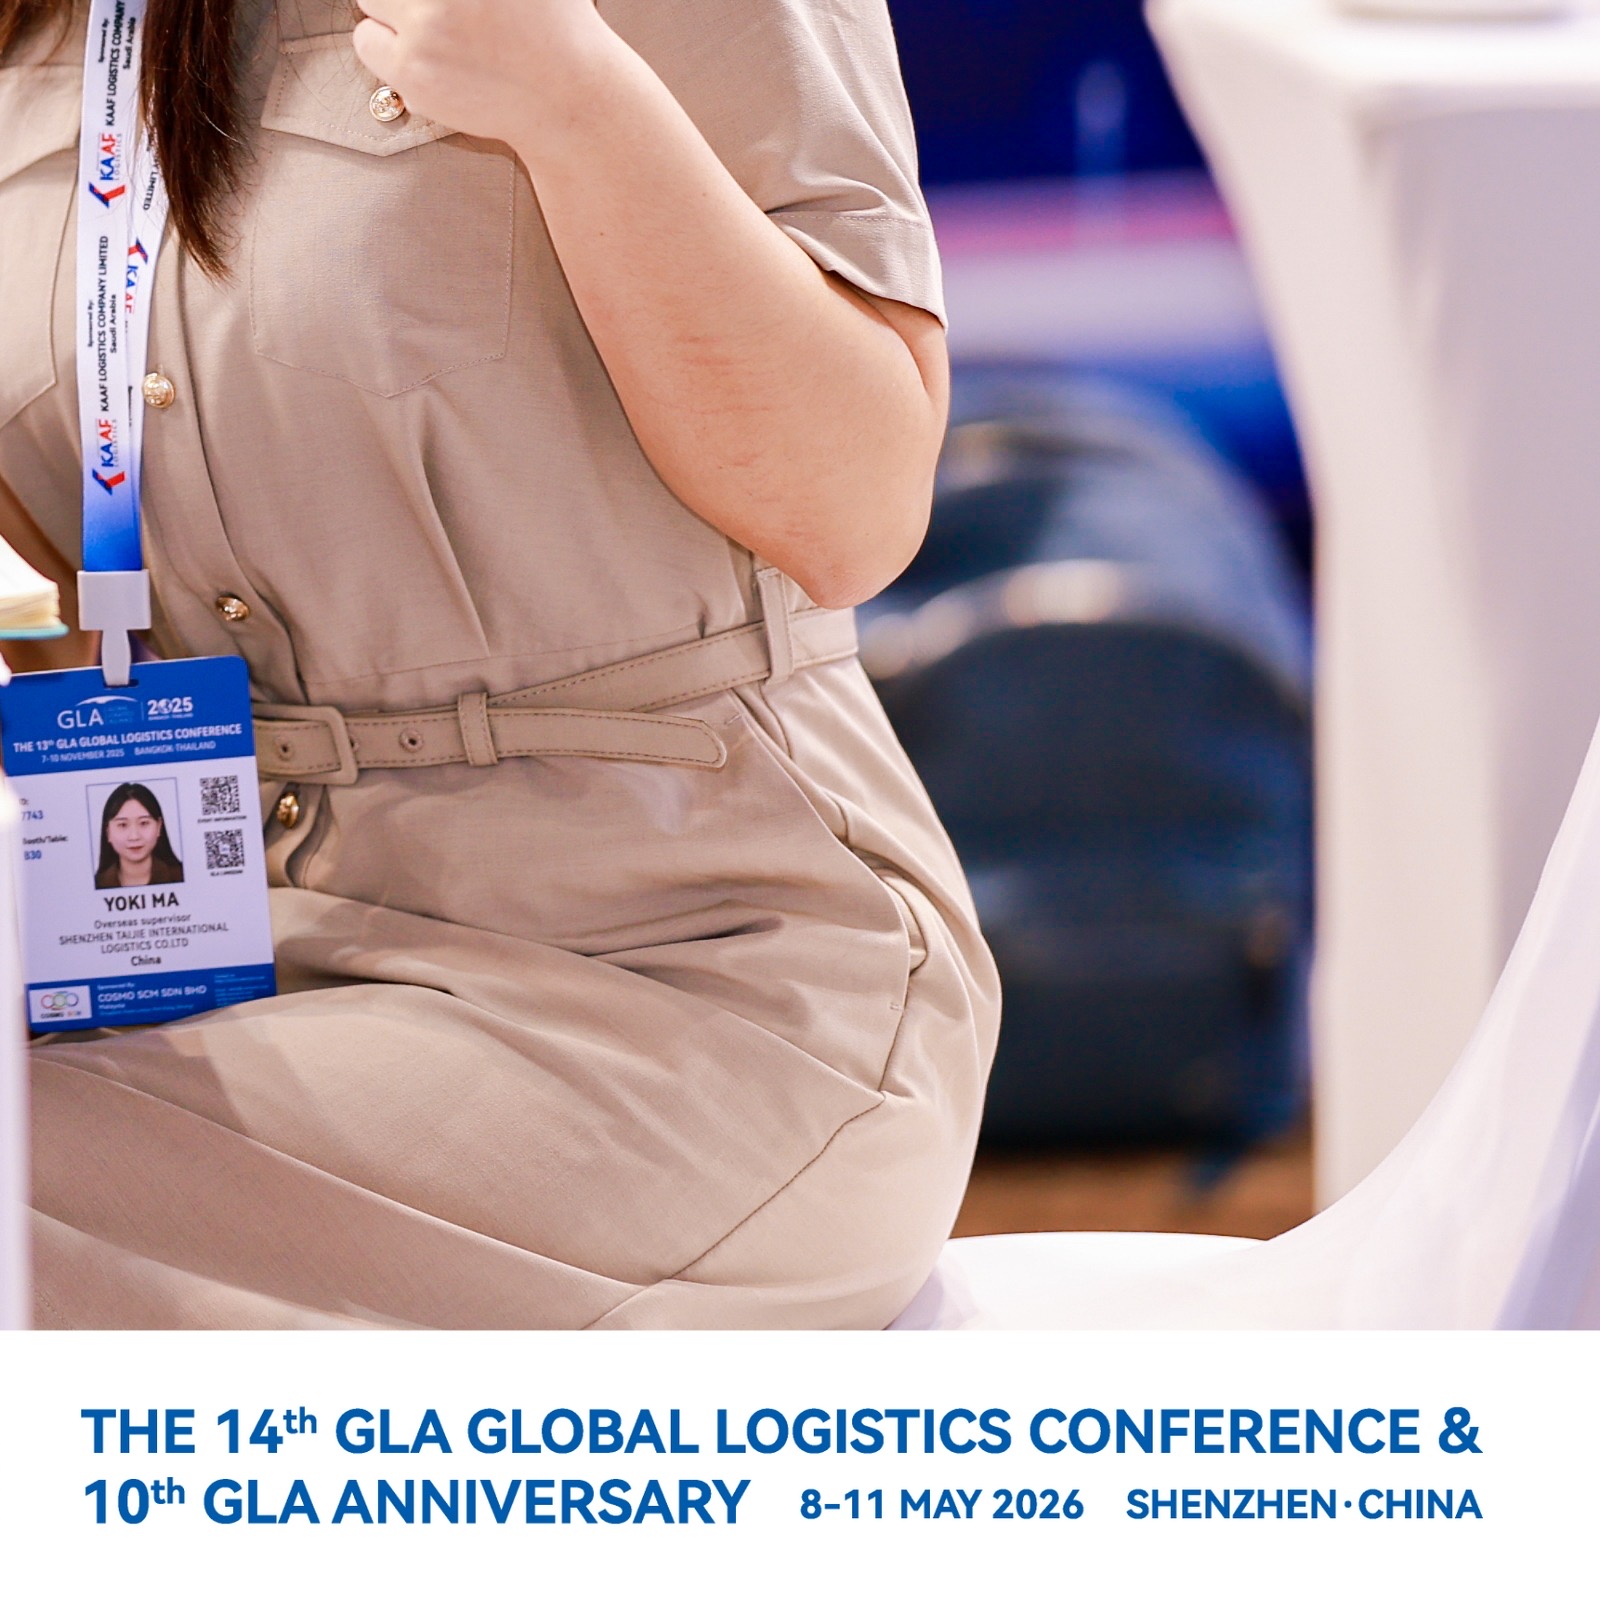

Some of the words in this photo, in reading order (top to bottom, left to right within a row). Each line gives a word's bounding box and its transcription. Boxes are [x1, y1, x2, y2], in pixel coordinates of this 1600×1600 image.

[112, 0, 125, 46] COMPANY
[122, 46, 132, 69] Saudi
[107, 48, 120, 96] LOGISTICS
[106, 98, 116, 126] KAAF
[100, 133, 117, 181] KAAF
[143, 171, 158, 211] LIMITED
[98, 236, 108, 275] LIMITED
[97, 278, 106, 327] COMPANY
[97, 329, 107, 381] LOGISTICS
[99, 384, 109, 412] KAAF
[99, 419, 114, 467] KAAF
[57, 708, 104, 729] GLA
[147, 697, 193, 716] 2025
[13, 741, 33, 753] THE
[56, 738, 78, 750] GLA
[79, 734, 120, 748] GLOBAL
[121, 729, 173, 744] LOGISTICS
[175, 723, 242, 740] CONFERENCE
[60, 751, 104, 762] NOVEMBER
[106, 748, 125, 758] 2025
[104, 894, 146, 912] YOKI
[152, 892, 179, 908] MA
[59, 931, 113, 945] SHENZHEN
[148, 922, 229, 938] INTERNATIONAL
[94, 918, 138, 930] Overseas
[140, 913, 191, 926] supervisor
[101, 940, 152, 954] LOGISTICS
[130, 954, 162, 967] China
[97, 991, 136, 1003] COSMO
[161, 987, 183, 998] SDN
[184, 985, 207, 996] BHD
